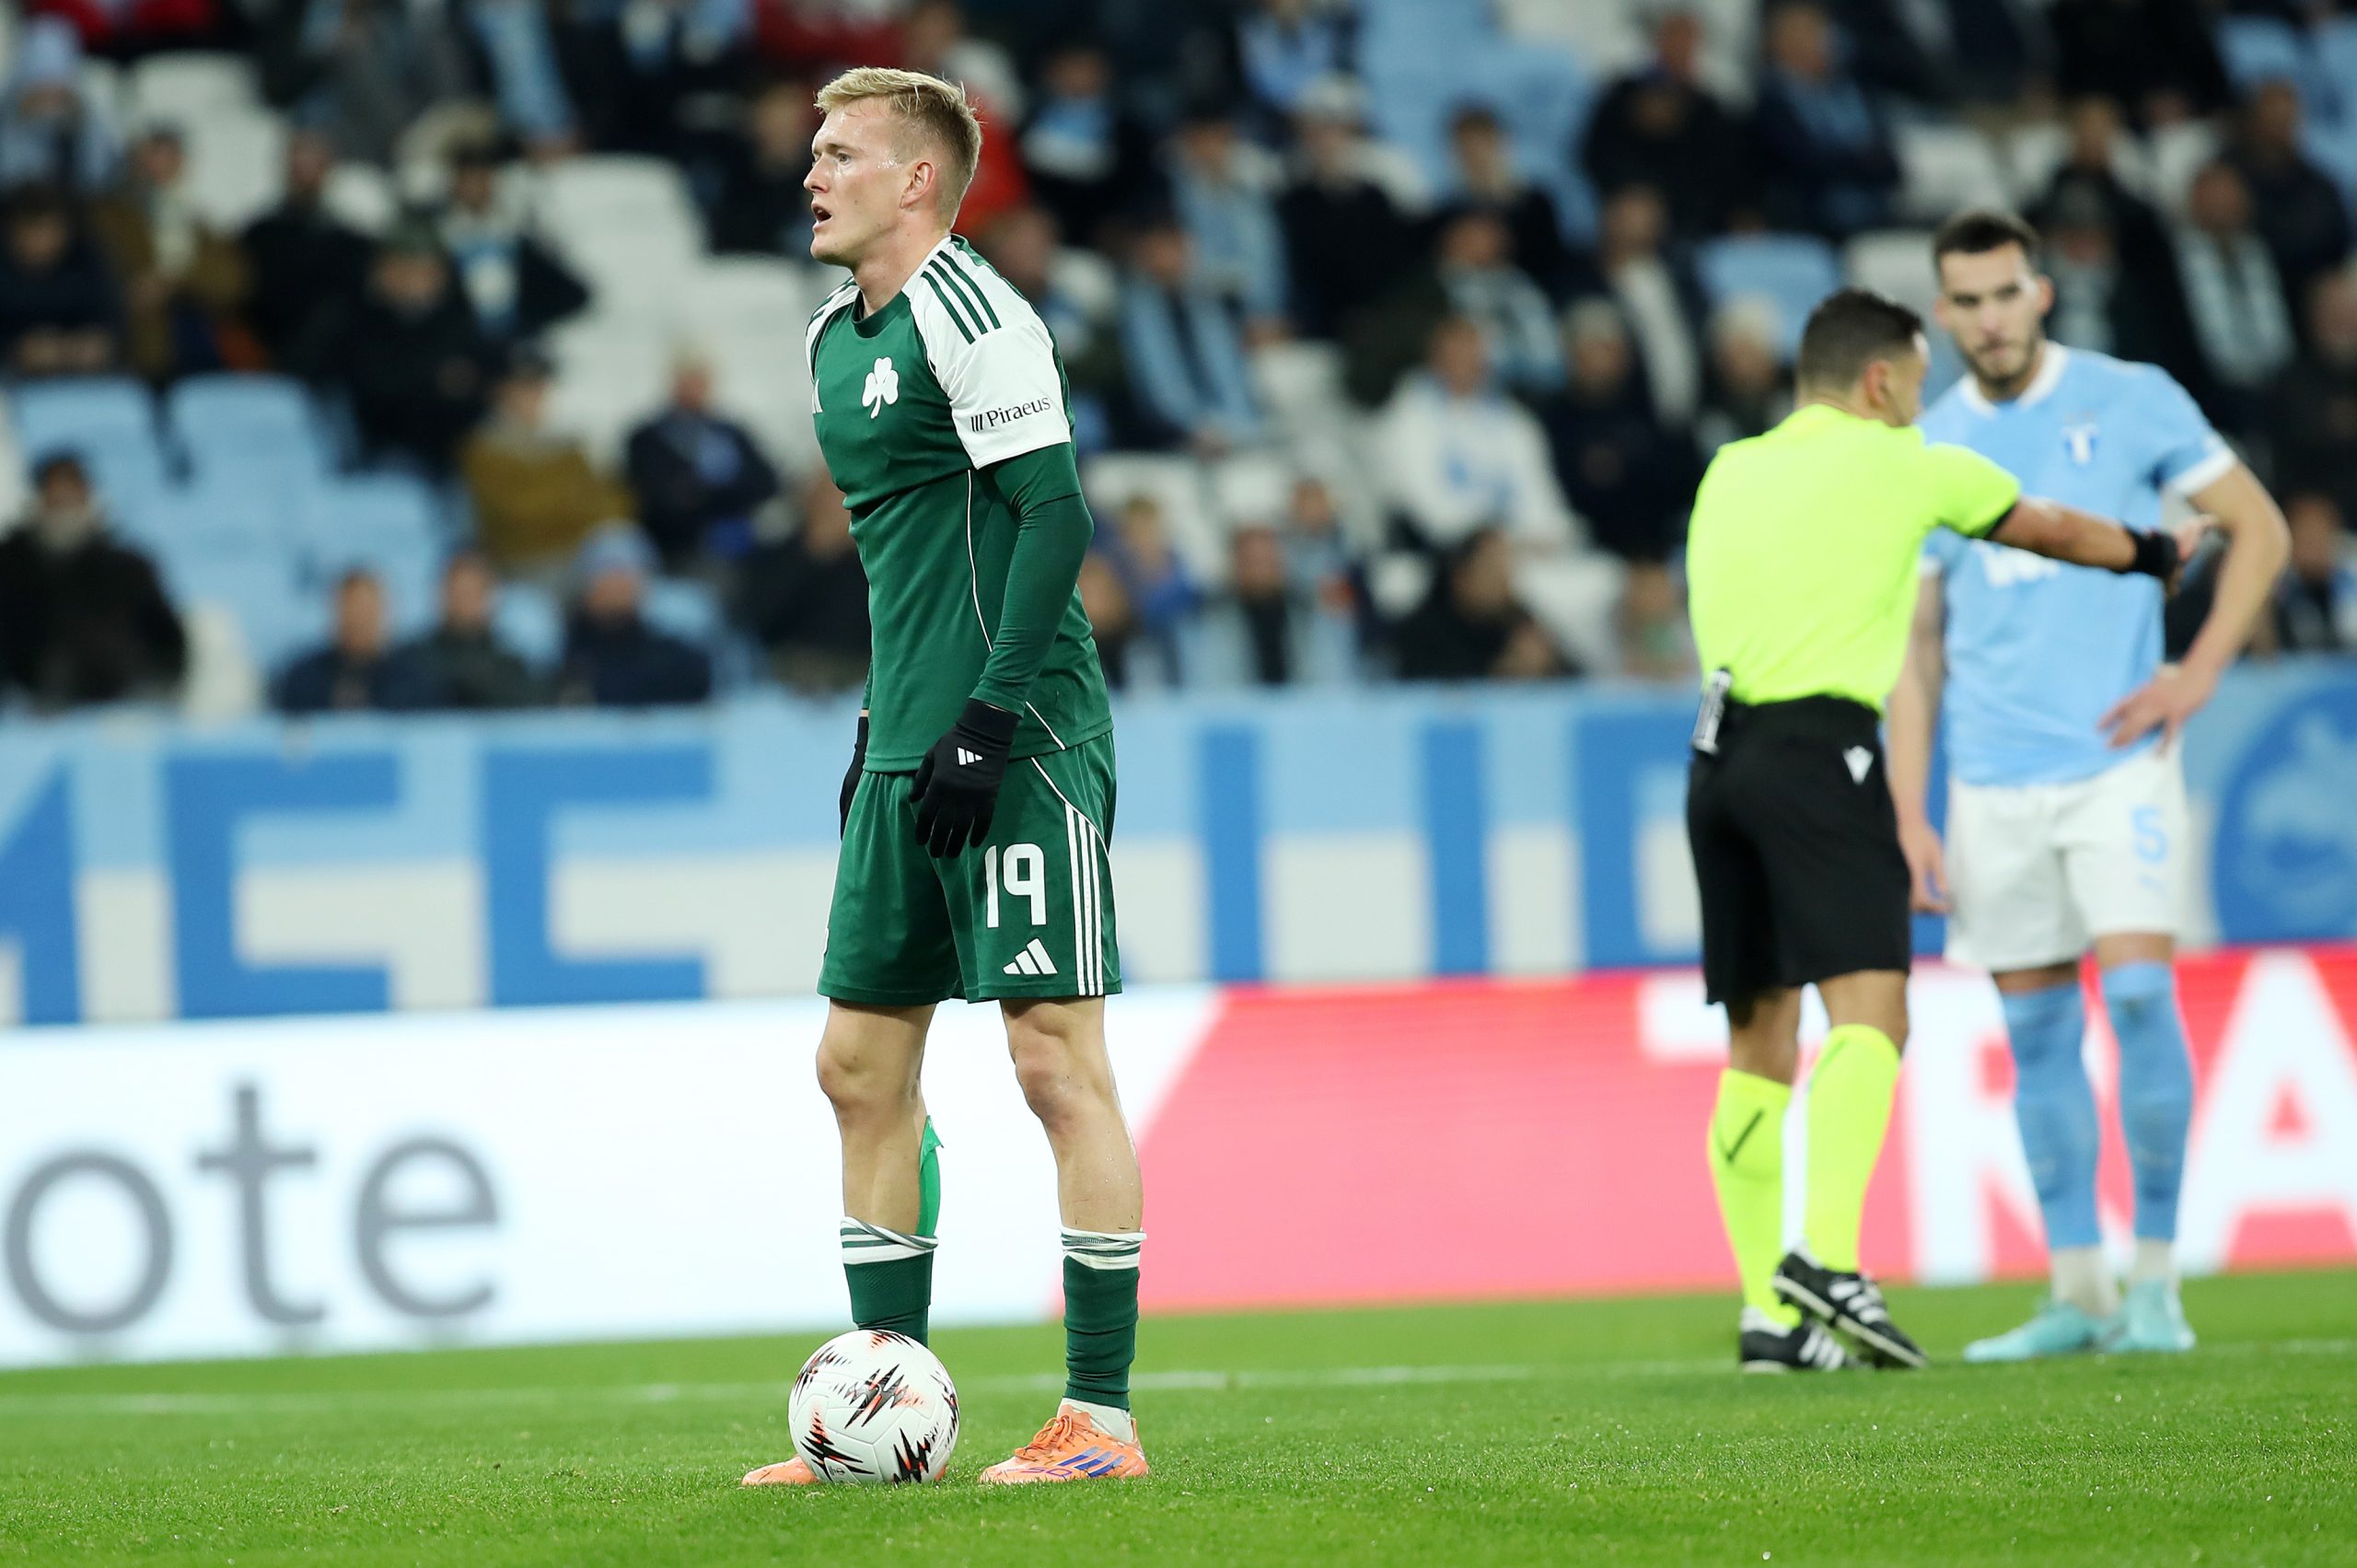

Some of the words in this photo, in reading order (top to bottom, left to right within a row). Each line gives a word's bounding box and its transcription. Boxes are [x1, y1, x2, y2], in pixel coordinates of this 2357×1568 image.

[985, 397, 1051, 427] Piraeus
[2130, 804, 2169, 865] 5
[984, 842, 1047, 929] 19
[3, 1077, 501, 1335] ote
